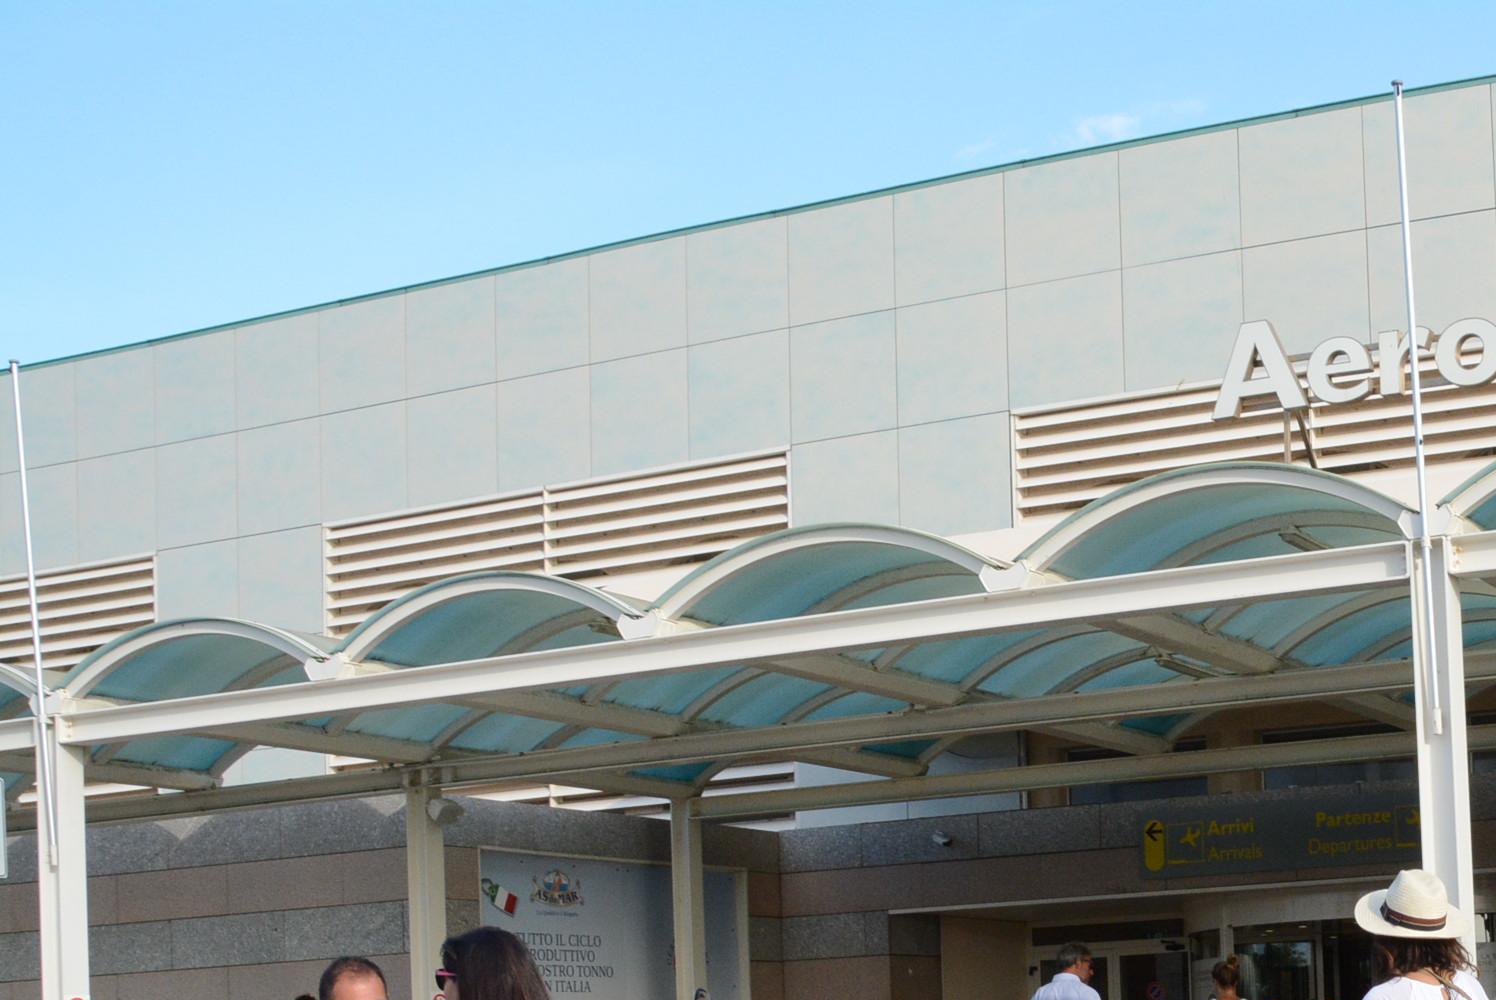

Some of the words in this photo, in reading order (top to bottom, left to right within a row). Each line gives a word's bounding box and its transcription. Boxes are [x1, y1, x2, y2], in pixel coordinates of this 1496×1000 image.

[1208, 816, 1256, 836] Arrivi
[1314, 811, 1393, 828] Partenze
[1307, 837, 1393, 856] Departures
[556, 934, 566, 946] IL
[568, 934, 602, 947] CICLO
[529, 948, 596, 962] RODUTTIVO
[538, 964, 575, 977] OSTRO
[575, 965, 614, 978] TONNO
[555, 980, 592, 993] ITALIA
